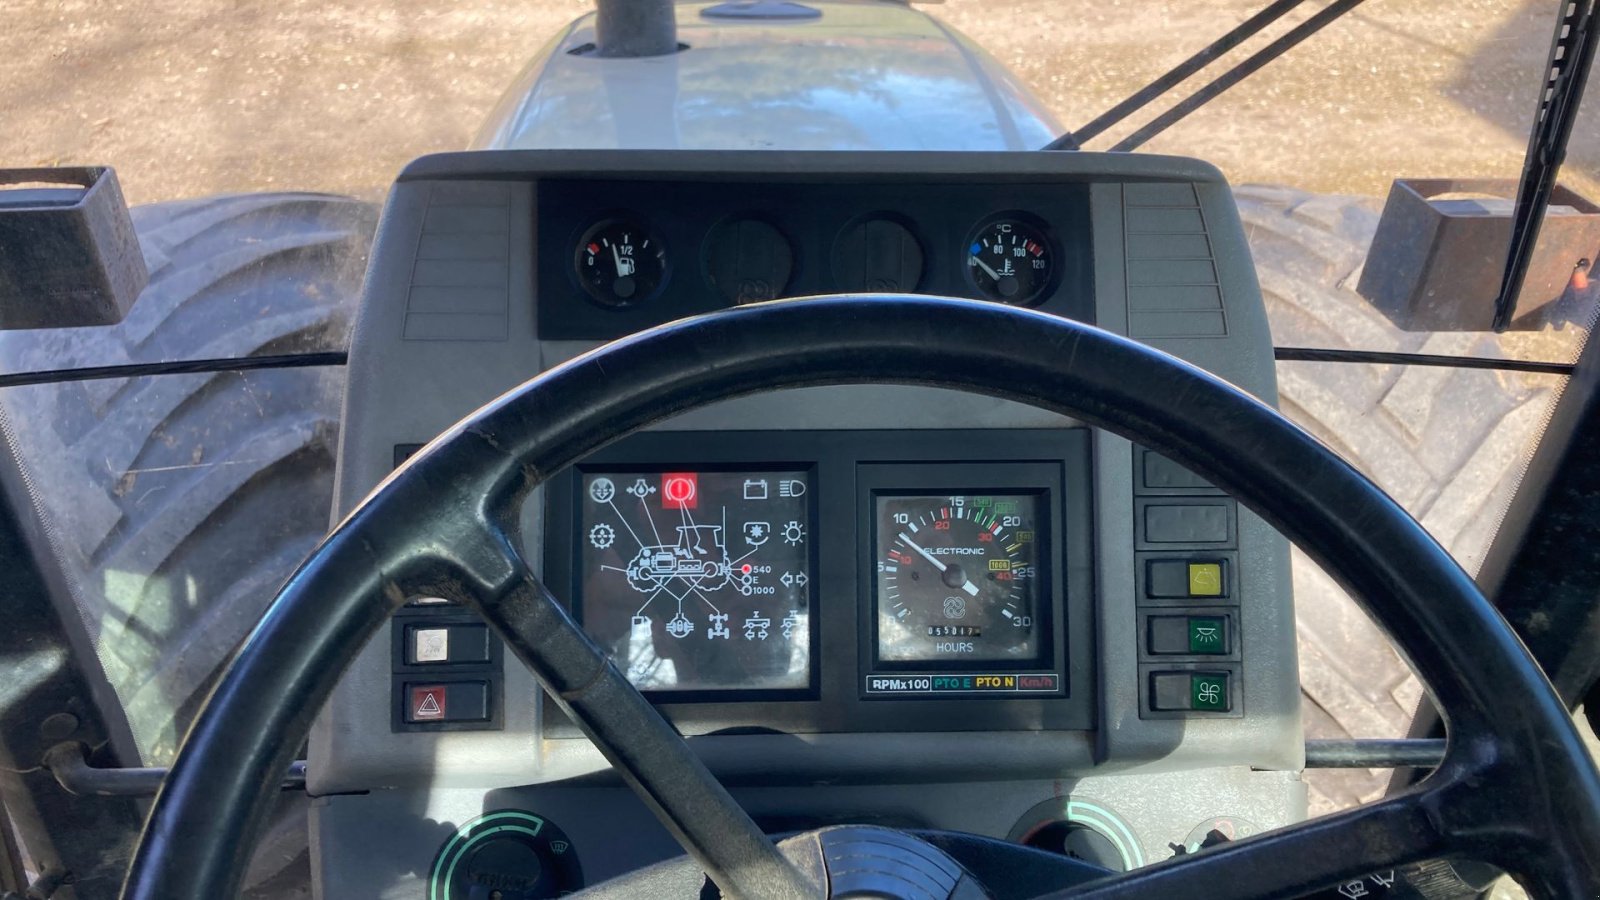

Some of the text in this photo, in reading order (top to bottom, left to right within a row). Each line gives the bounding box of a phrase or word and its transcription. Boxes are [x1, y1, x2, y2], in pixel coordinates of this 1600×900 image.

[620, 245, 633, 256] 1/2
[993, 244, 1004, 255] 80
[1013, 247, 1026, 258] 100
[588, 256, 594, 266] 0
[1032, 260, 1045, 270] 120
[949, 496, 965, 507] 15
[893, 513, 908, 524] 10
[1003, 516, 1020, 527] 20
[935, 521, 950, 530] 20
[978, 533, 992, 542] 30
[753, 566, 772, 574] 540
[1018, 567, 1035, 578] 25
[996, 572, 1012, 580] 40
[1013, 616, 1031, 627] 30
[936, 642, 974, 653] HOURS
[872, 679, 929, 689] RPMx100
[934, 678, 971, 688] PTO E
[976, 677, 1014, 687] PTO N
[1020, 676, 1053, 687] Km/h
